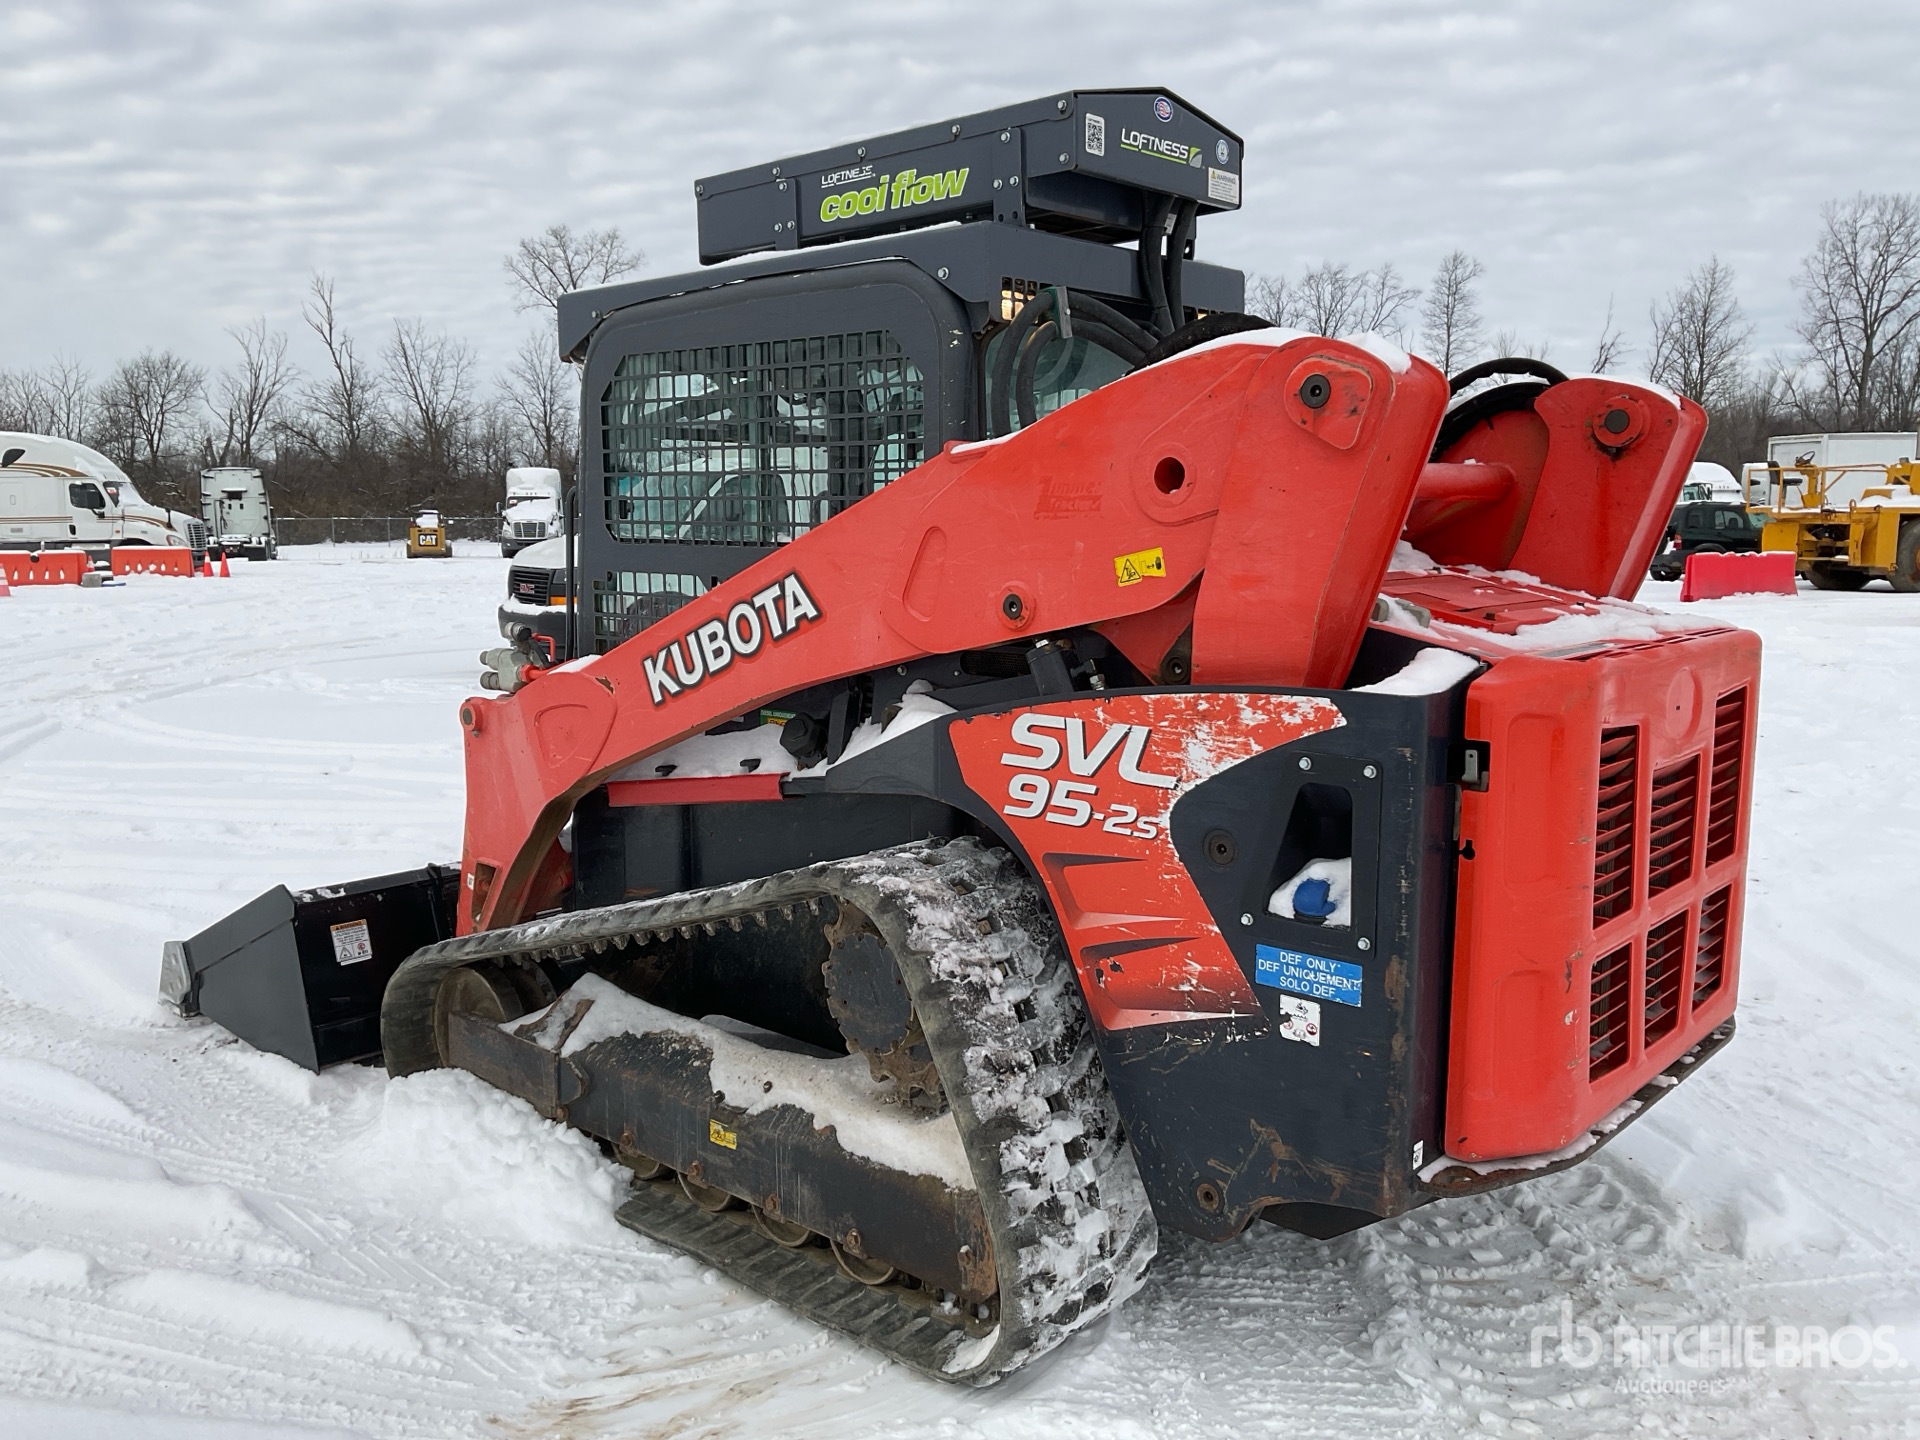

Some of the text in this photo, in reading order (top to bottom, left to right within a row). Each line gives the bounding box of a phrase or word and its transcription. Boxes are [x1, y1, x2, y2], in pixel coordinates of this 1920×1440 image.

[1121, 128, 1189, 159] LOFTNESS
[891, 168, 970, 210] flow
[419, 534, 437, 546] CAT
[642, 572, 819, 705] KUBOTA
[1000, 712, 1178, 790] SVL
[1258, 959, 1361, 990] DEF UNIQUEMENT
[1280, 951, 1336, 973] DEF ONLY
[1280, 976, 1336, 997] SOLO DEF
